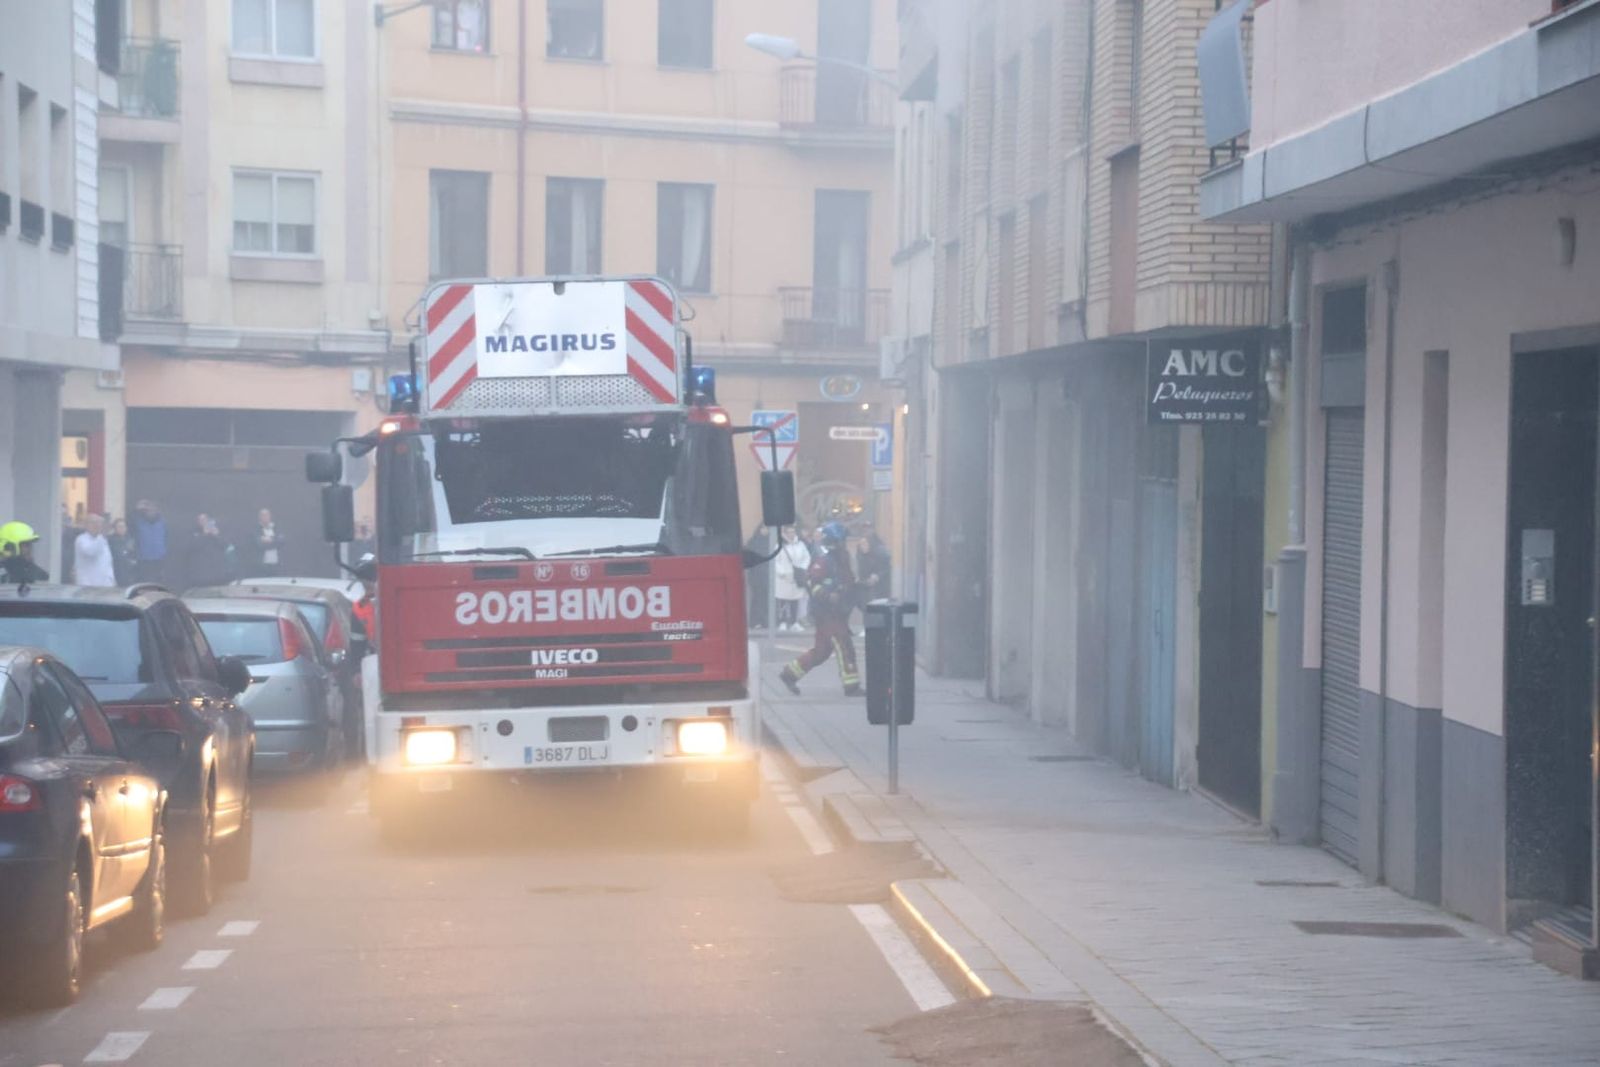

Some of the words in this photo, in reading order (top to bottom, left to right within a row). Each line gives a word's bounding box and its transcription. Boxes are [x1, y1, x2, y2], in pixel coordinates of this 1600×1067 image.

[485, 333, 616, 353] MAGIRUS
[1161, 349, 1247, 376] AMC
[574, 565, 588, 577] 16
[531, 649, 598, 665] IVECO
[535, 669, 567, 678] MAGI
[535, 747, 574, 762] 3687
